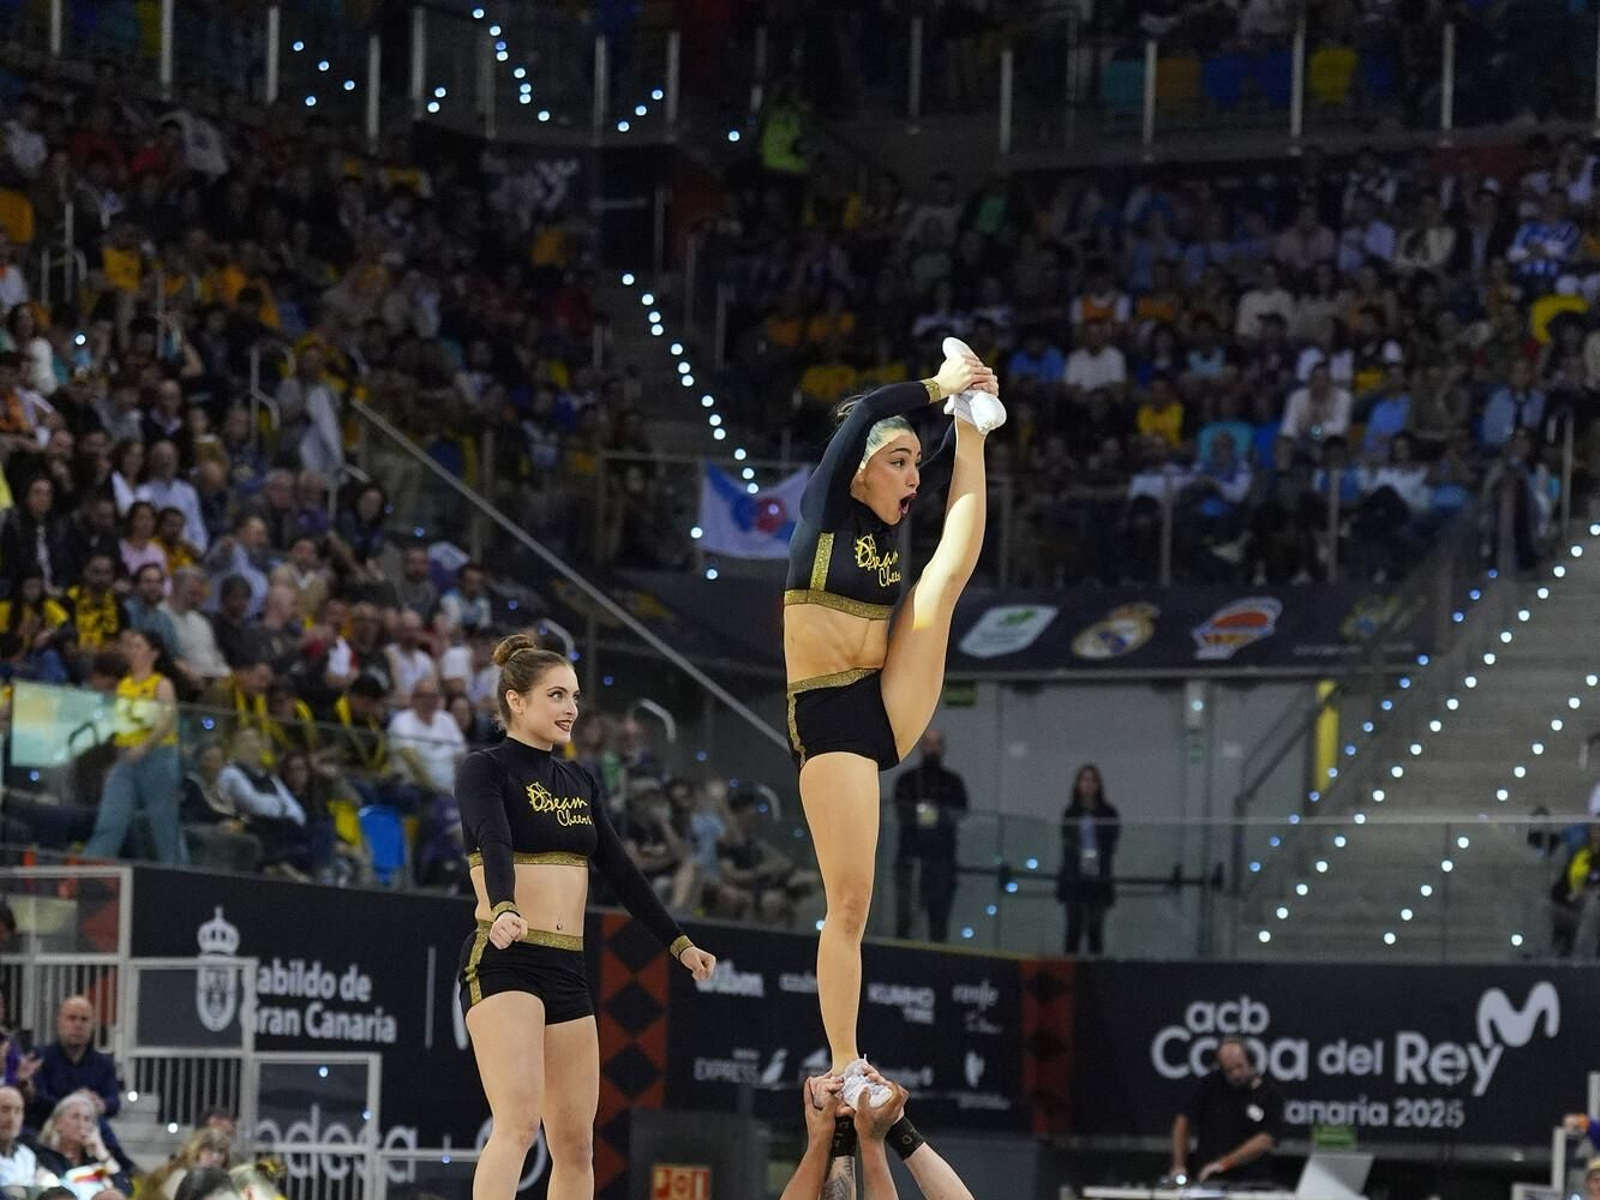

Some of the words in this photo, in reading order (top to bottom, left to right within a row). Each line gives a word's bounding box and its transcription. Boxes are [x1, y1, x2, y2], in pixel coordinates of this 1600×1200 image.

[525, 782, 588, 813] Dream
[254, 957, 337, 1001] abildo
[340, 963, 373, 1002] de
[304, 1002, 397, 1043] Canaria
[1185, 995, 1271, 1035] acb
[1318, 1038, 1384, 1076] del
[1394, 1031, 1504, 1097] Rey
[1284, 1095, 1389, 1128] anaria
